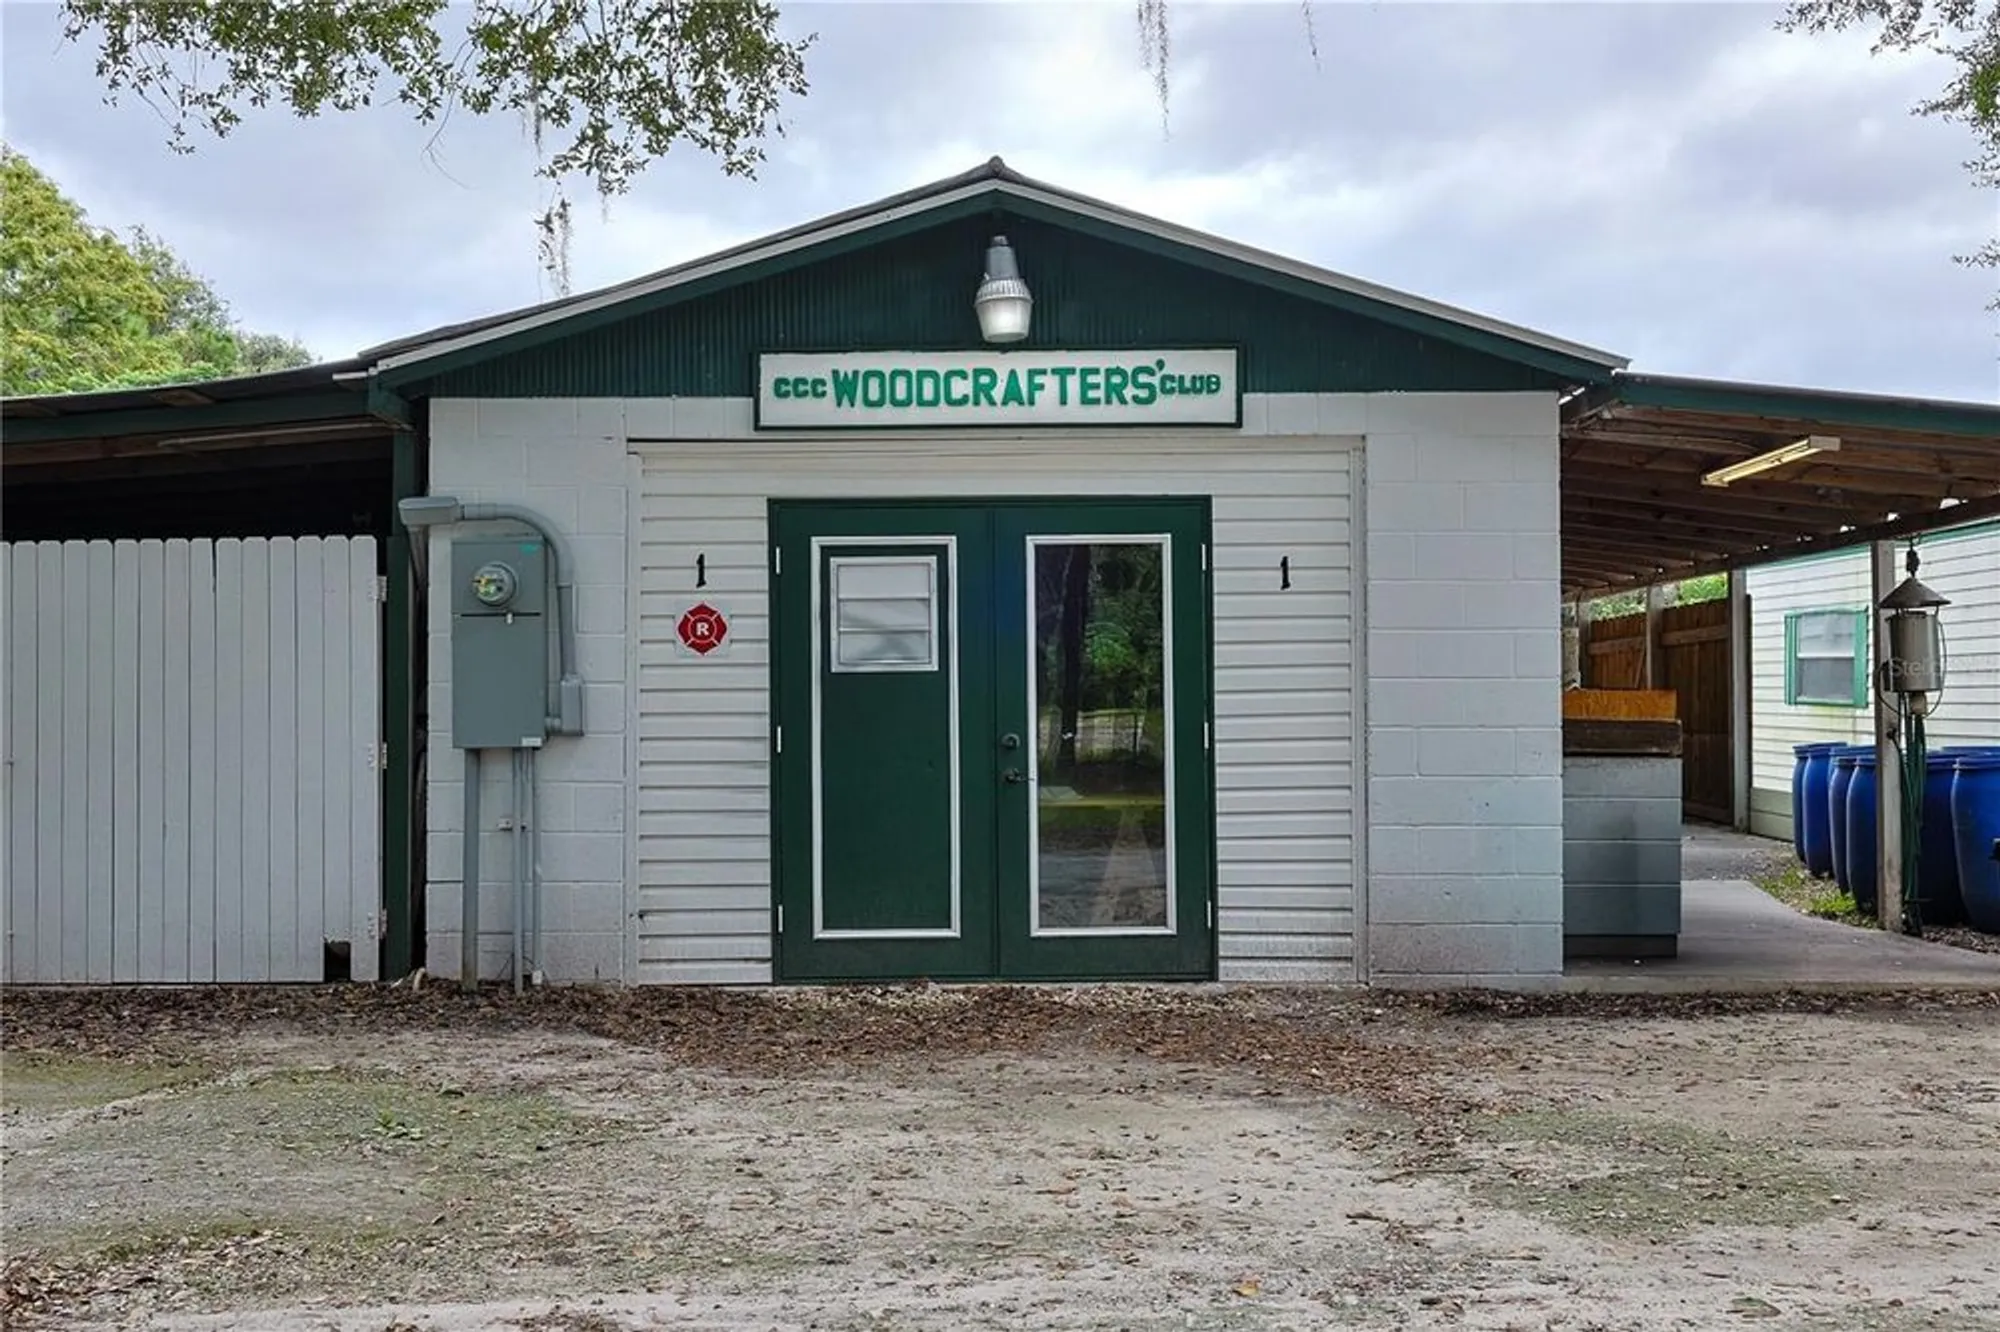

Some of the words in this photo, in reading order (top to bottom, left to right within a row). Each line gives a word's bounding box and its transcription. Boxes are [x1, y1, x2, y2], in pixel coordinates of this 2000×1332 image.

[773, 377, 827, 399] CCC
[831, 358, 1165, 408] WOODCRAFTERS'
[1159, 373, 1221, 396] CLUB
[696, 553, 707, 589] 1
[1280, 555, 1291, 591] 1
[696, 621, 710, 637] R
